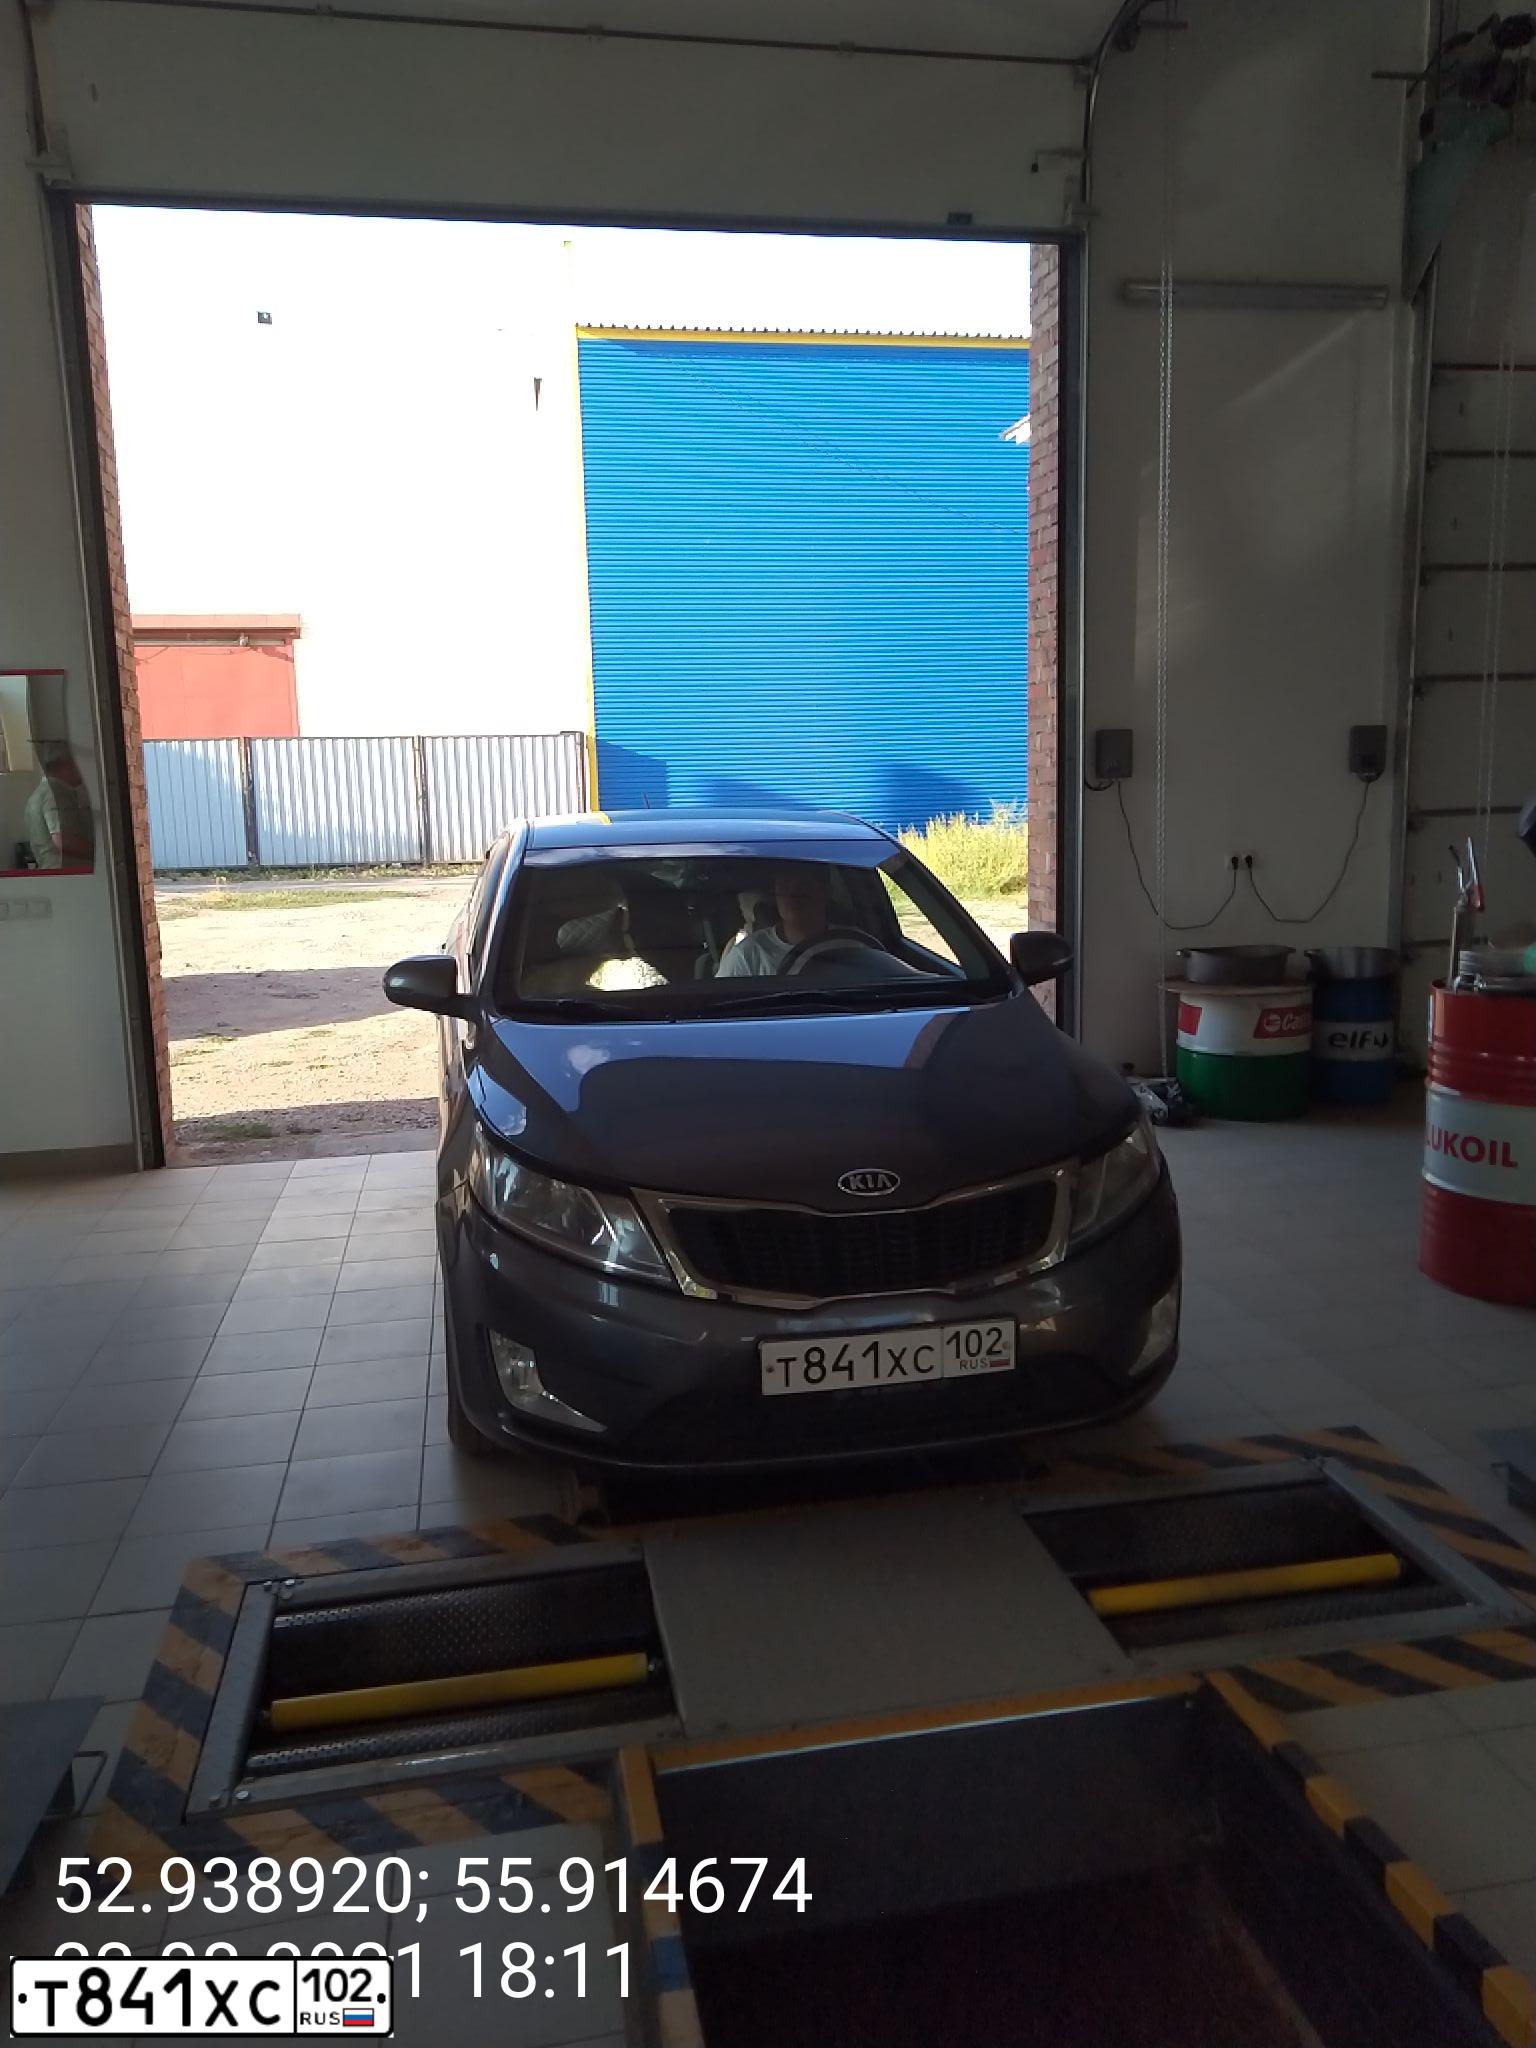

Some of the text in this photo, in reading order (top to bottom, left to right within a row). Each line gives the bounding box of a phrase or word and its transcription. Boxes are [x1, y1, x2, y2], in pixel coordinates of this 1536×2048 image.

[849, 1173, 893, 1191] KIA
[945, 1327, 1003, 1360] 102
[959, 1355, 988, 1371] RUS
